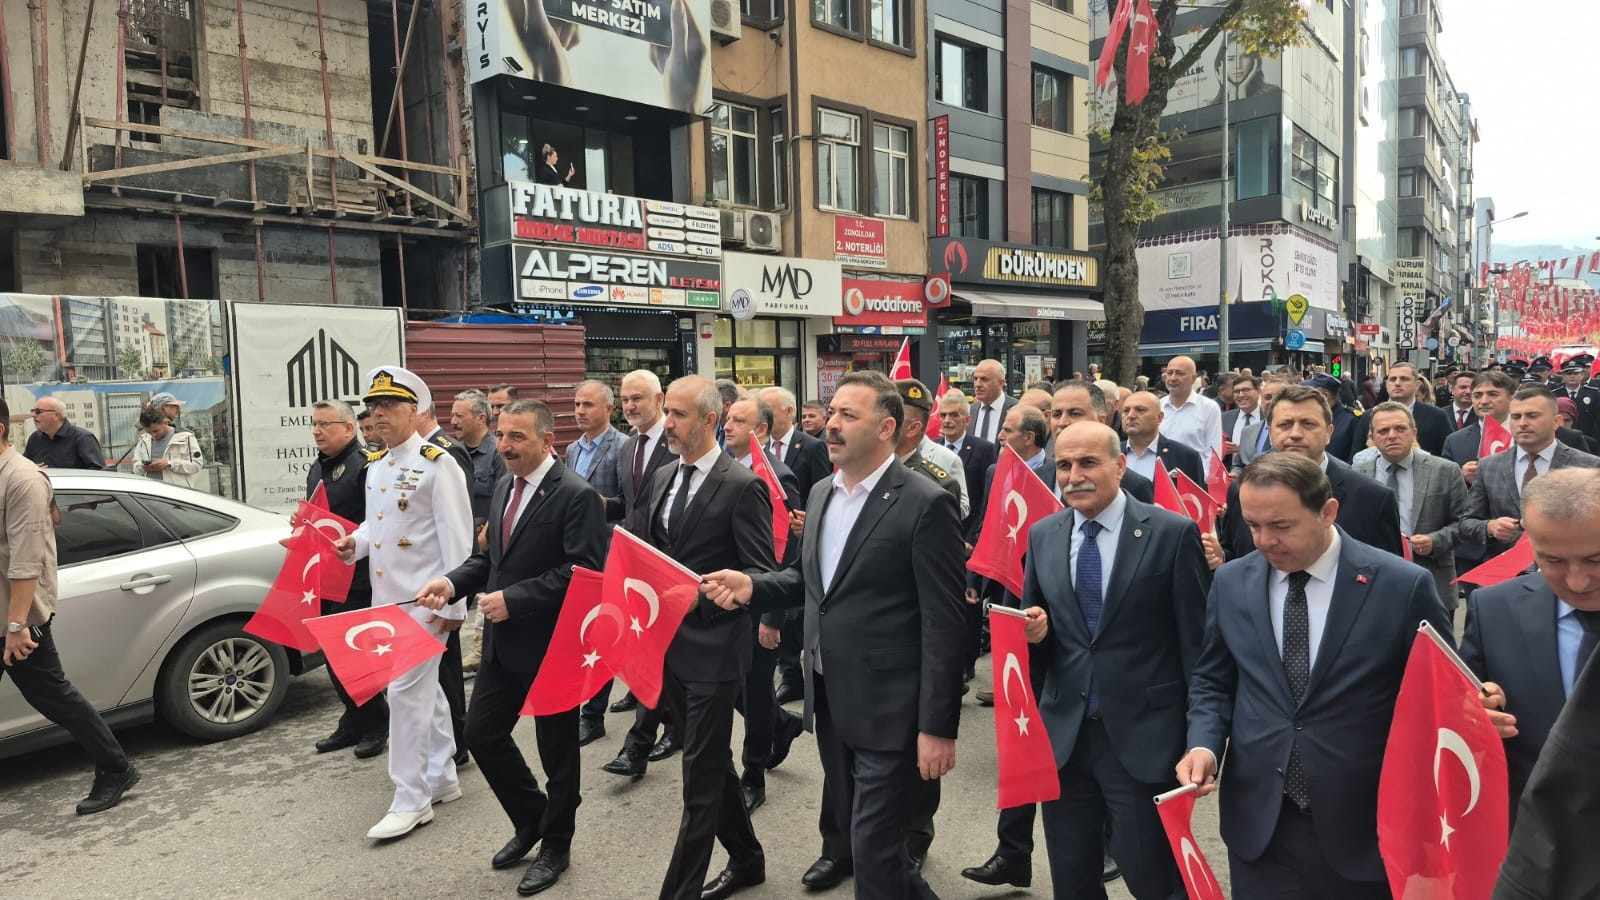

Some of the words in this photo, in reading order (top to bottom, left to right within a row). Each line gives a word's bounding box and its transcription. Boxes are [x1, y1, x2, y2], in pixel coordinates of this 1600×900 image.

[571, 1, 645, 34] MERKEZİ
[938, 139, 947, 234] NOTERLİĞİ
[513, 184, 643, 228] FATURA
[515, 216, 574, 242] ÖDEME
[575, 226, 643, 249] NOKTASI
[844, 228, 876, 238] ZONGULDAK
[657, 242, 675, 252] ADSL
[836, 240, 843, 250] 2.
[845, 241, 883, 254] NOTERLİĞİ
[520, 248, 668, 286] ALPEREN
[1001, 249, 1087, 282] DÜRÜMDEN
[1260, 238, 1275, 299] ROKA
[760, 262, 813, 299] MAD
[538, 285, 563, 295] iPhone
[732, 297, 749, 310] MAD
[765, 302, 809, 311] PARFUMEUR
[866, 296, 923, 313] vodafone
[1180, 315, 1220, 332] FIRA
[1401, 297, 1413, 347] DeFacto
[822, 372, 832, 382] 30
[288, 462, 299, 475] İŞ
